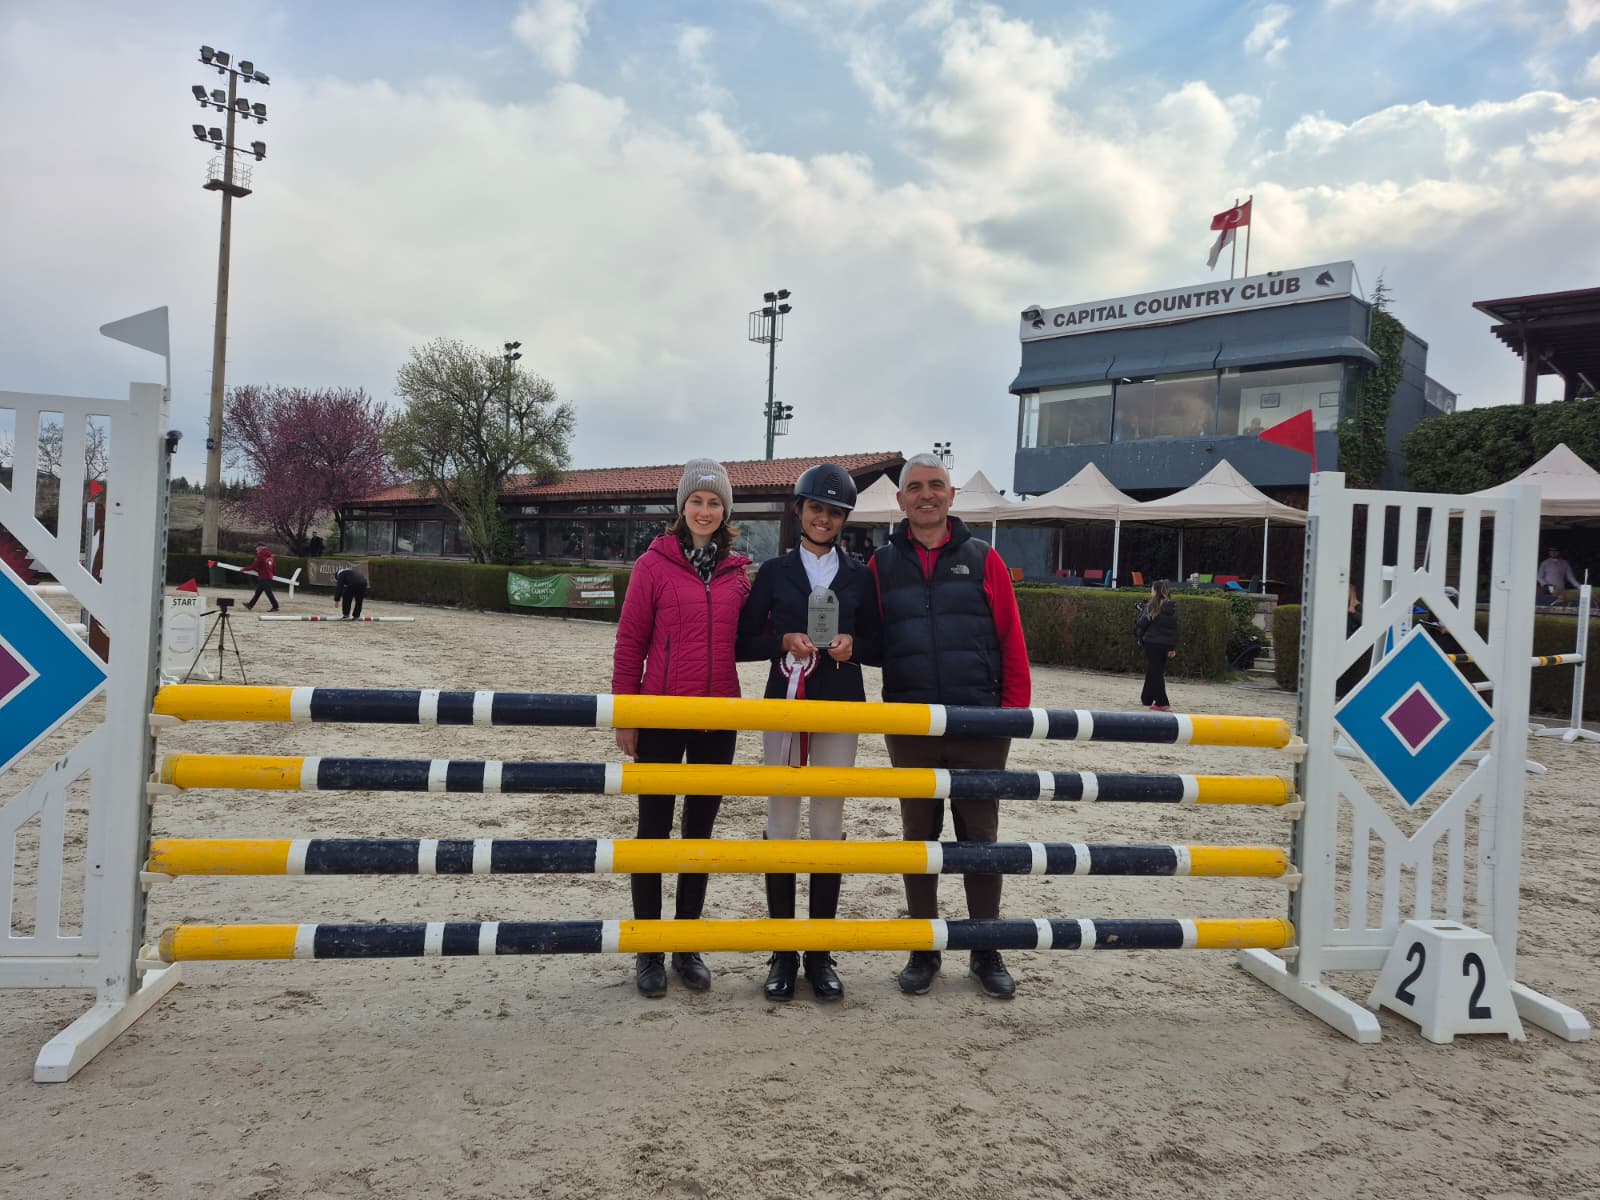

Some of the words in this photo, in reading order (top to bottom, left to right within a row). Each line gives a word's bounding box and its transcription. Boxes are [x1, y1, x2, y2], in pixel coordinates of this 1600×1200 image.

[1053, 304, 1127, 327] CAPITAL
[1134, 287, 1235, 315] COUNTRY
[1241, 277, 1301, 300] CLUB
[172, 598, 197, 606] START
[1395, 941, 1426, 1006] 2
[1462, 952, 1492, 1019] 2
